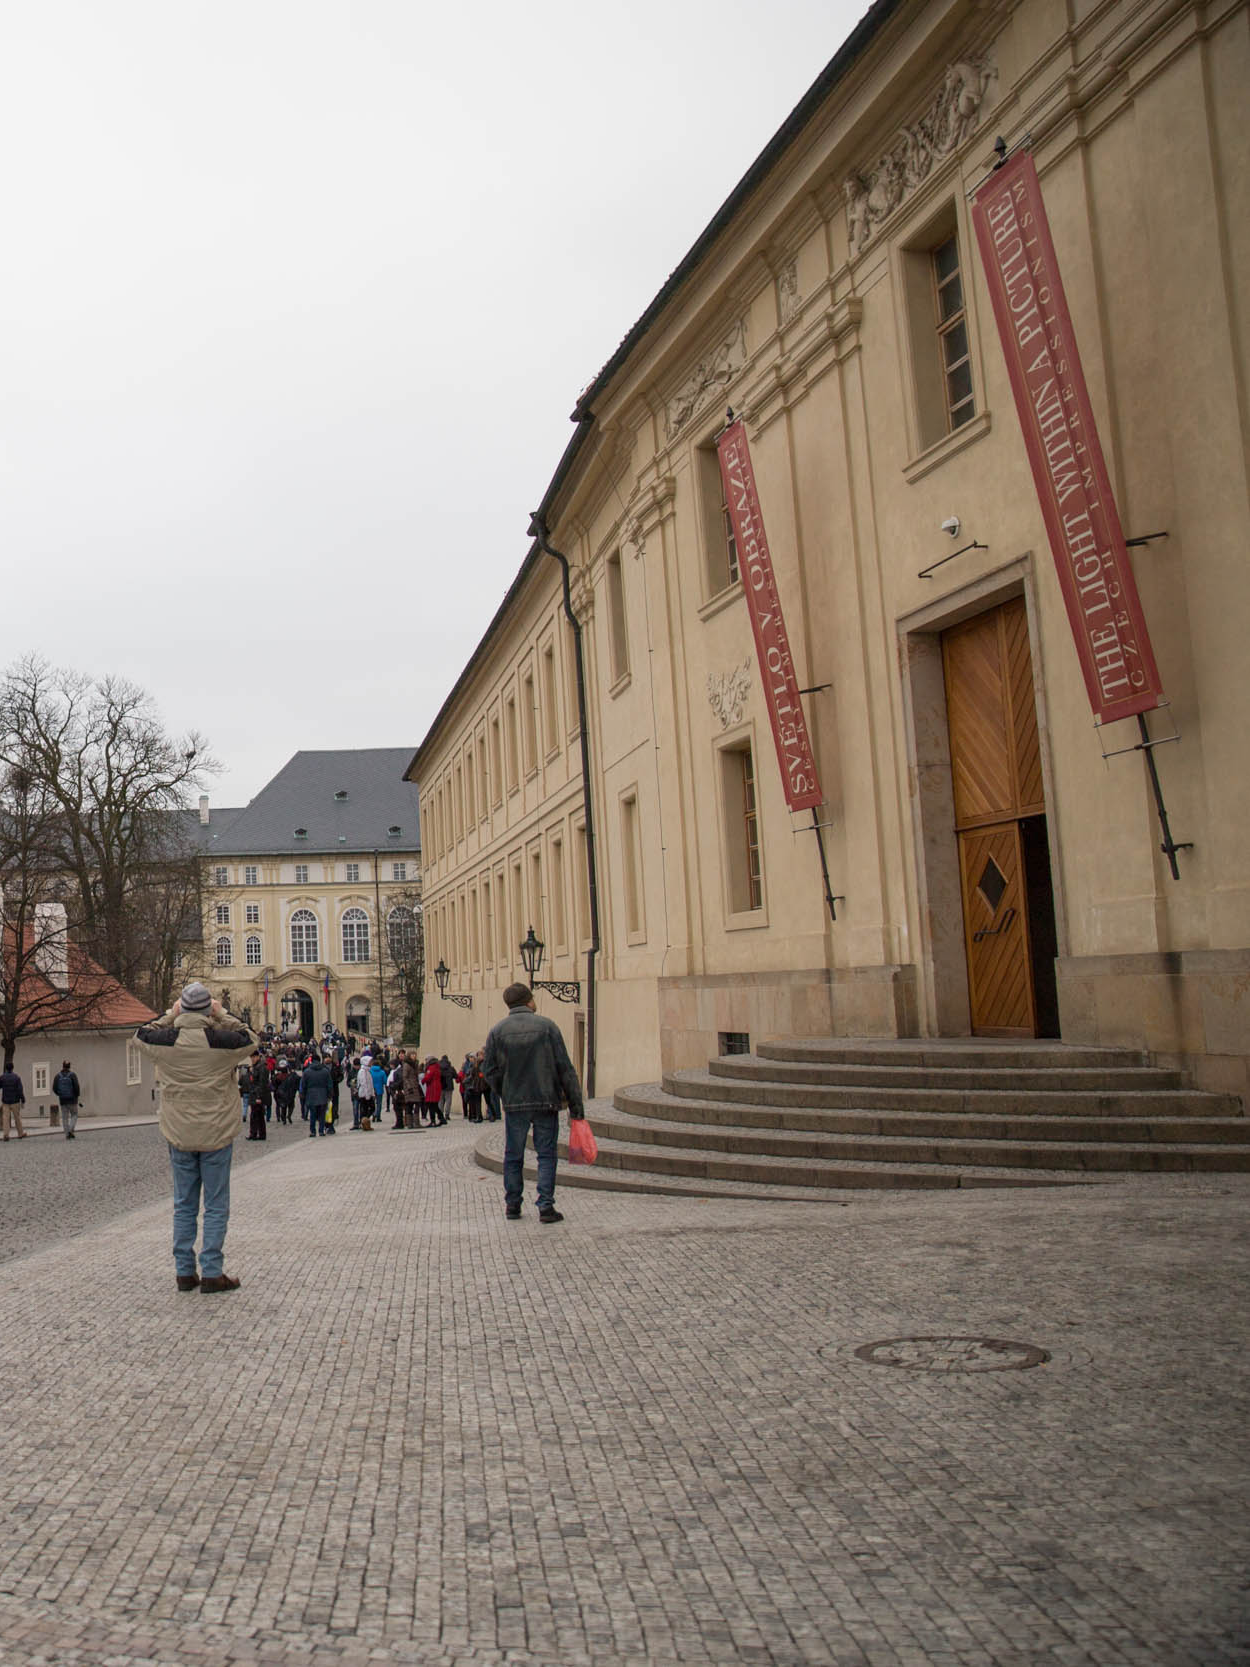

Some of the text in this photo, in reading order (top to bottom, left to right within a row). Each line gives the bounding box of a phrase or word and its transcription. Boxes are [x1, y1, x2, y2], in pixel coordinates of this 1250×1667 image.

[725, 442, 808, 794] SVĚTLO V OBRAZE
[988, 191, 1130, 698] THE LIGHT WITHIN A PICTURE
[1011, 179, 1145, 688] CZECH IMPRESSIONISM
